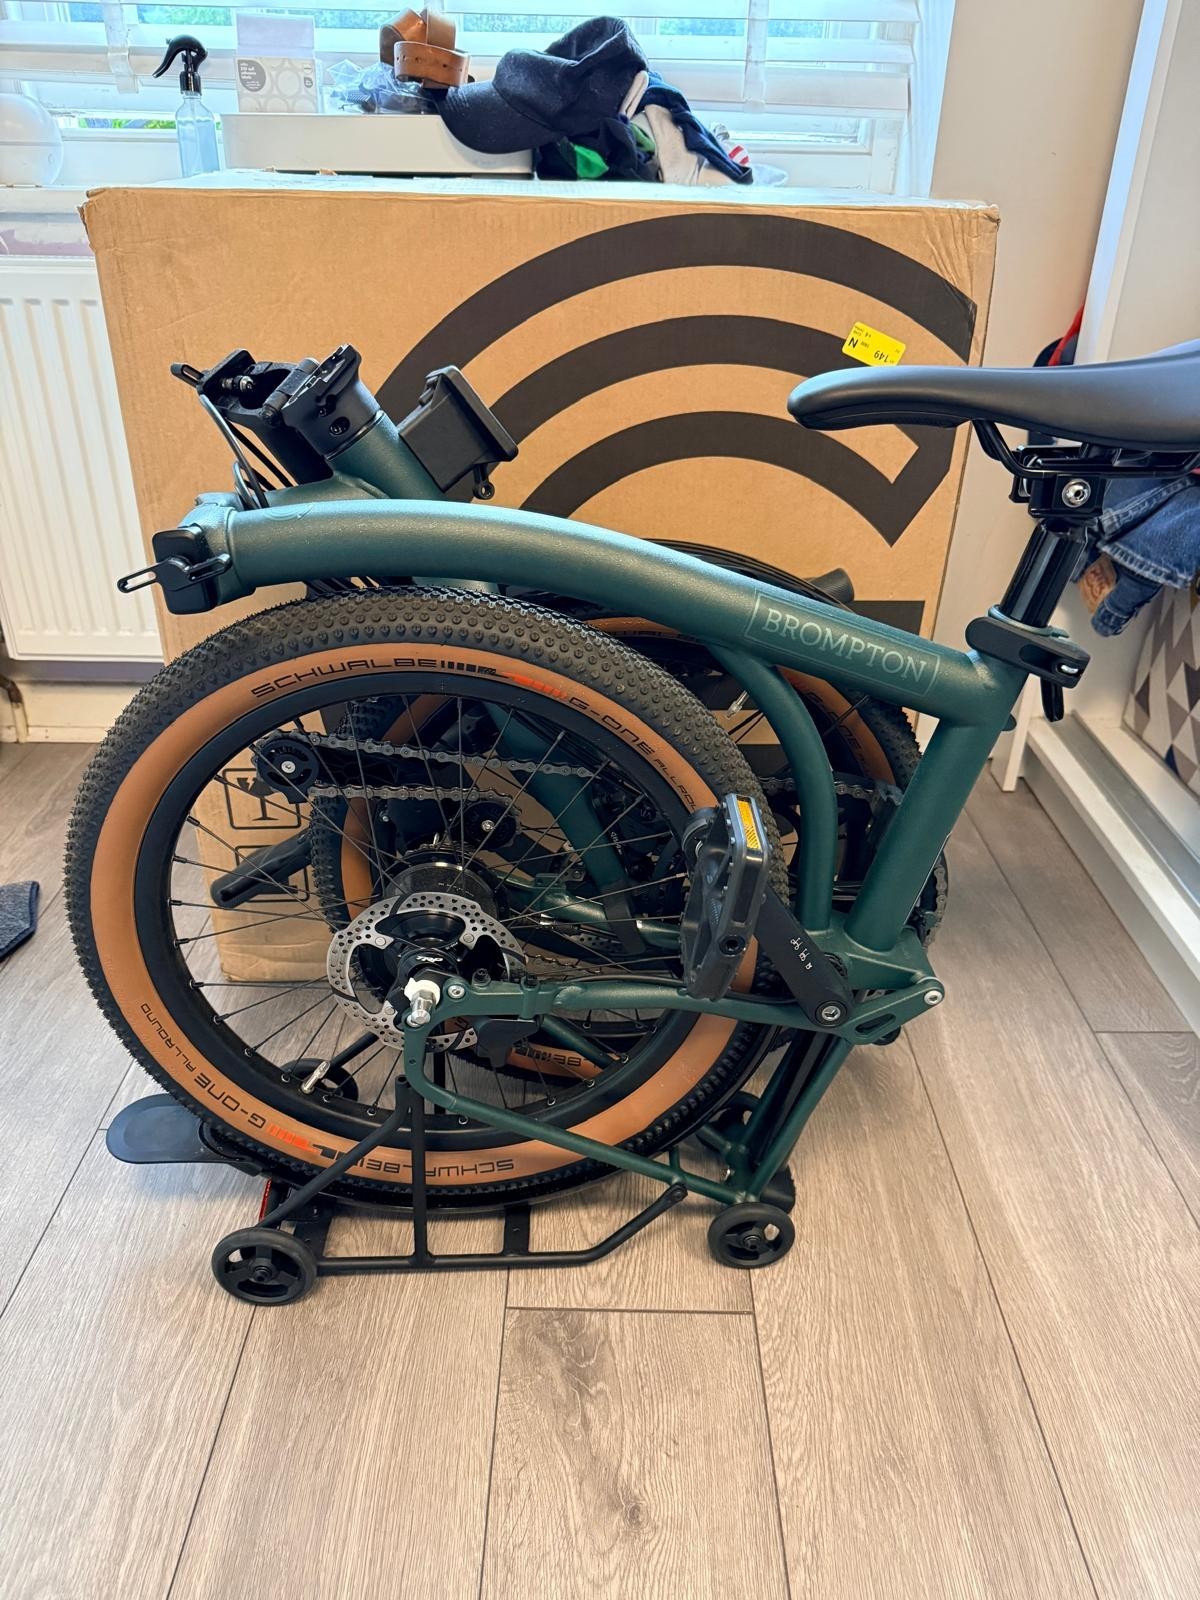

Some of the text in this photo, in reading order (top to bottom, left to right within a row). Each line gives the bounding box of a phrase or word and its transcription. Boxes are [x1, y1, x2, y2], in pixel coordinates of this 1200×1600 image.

[250, 657, 437, 698] SCHWALBE
[761, 607, 928, 683] BROMPTON
[568, 696, 656, 756] G-ONE
[140, 1002, 268, 1130] G-ONE ALLROUND
